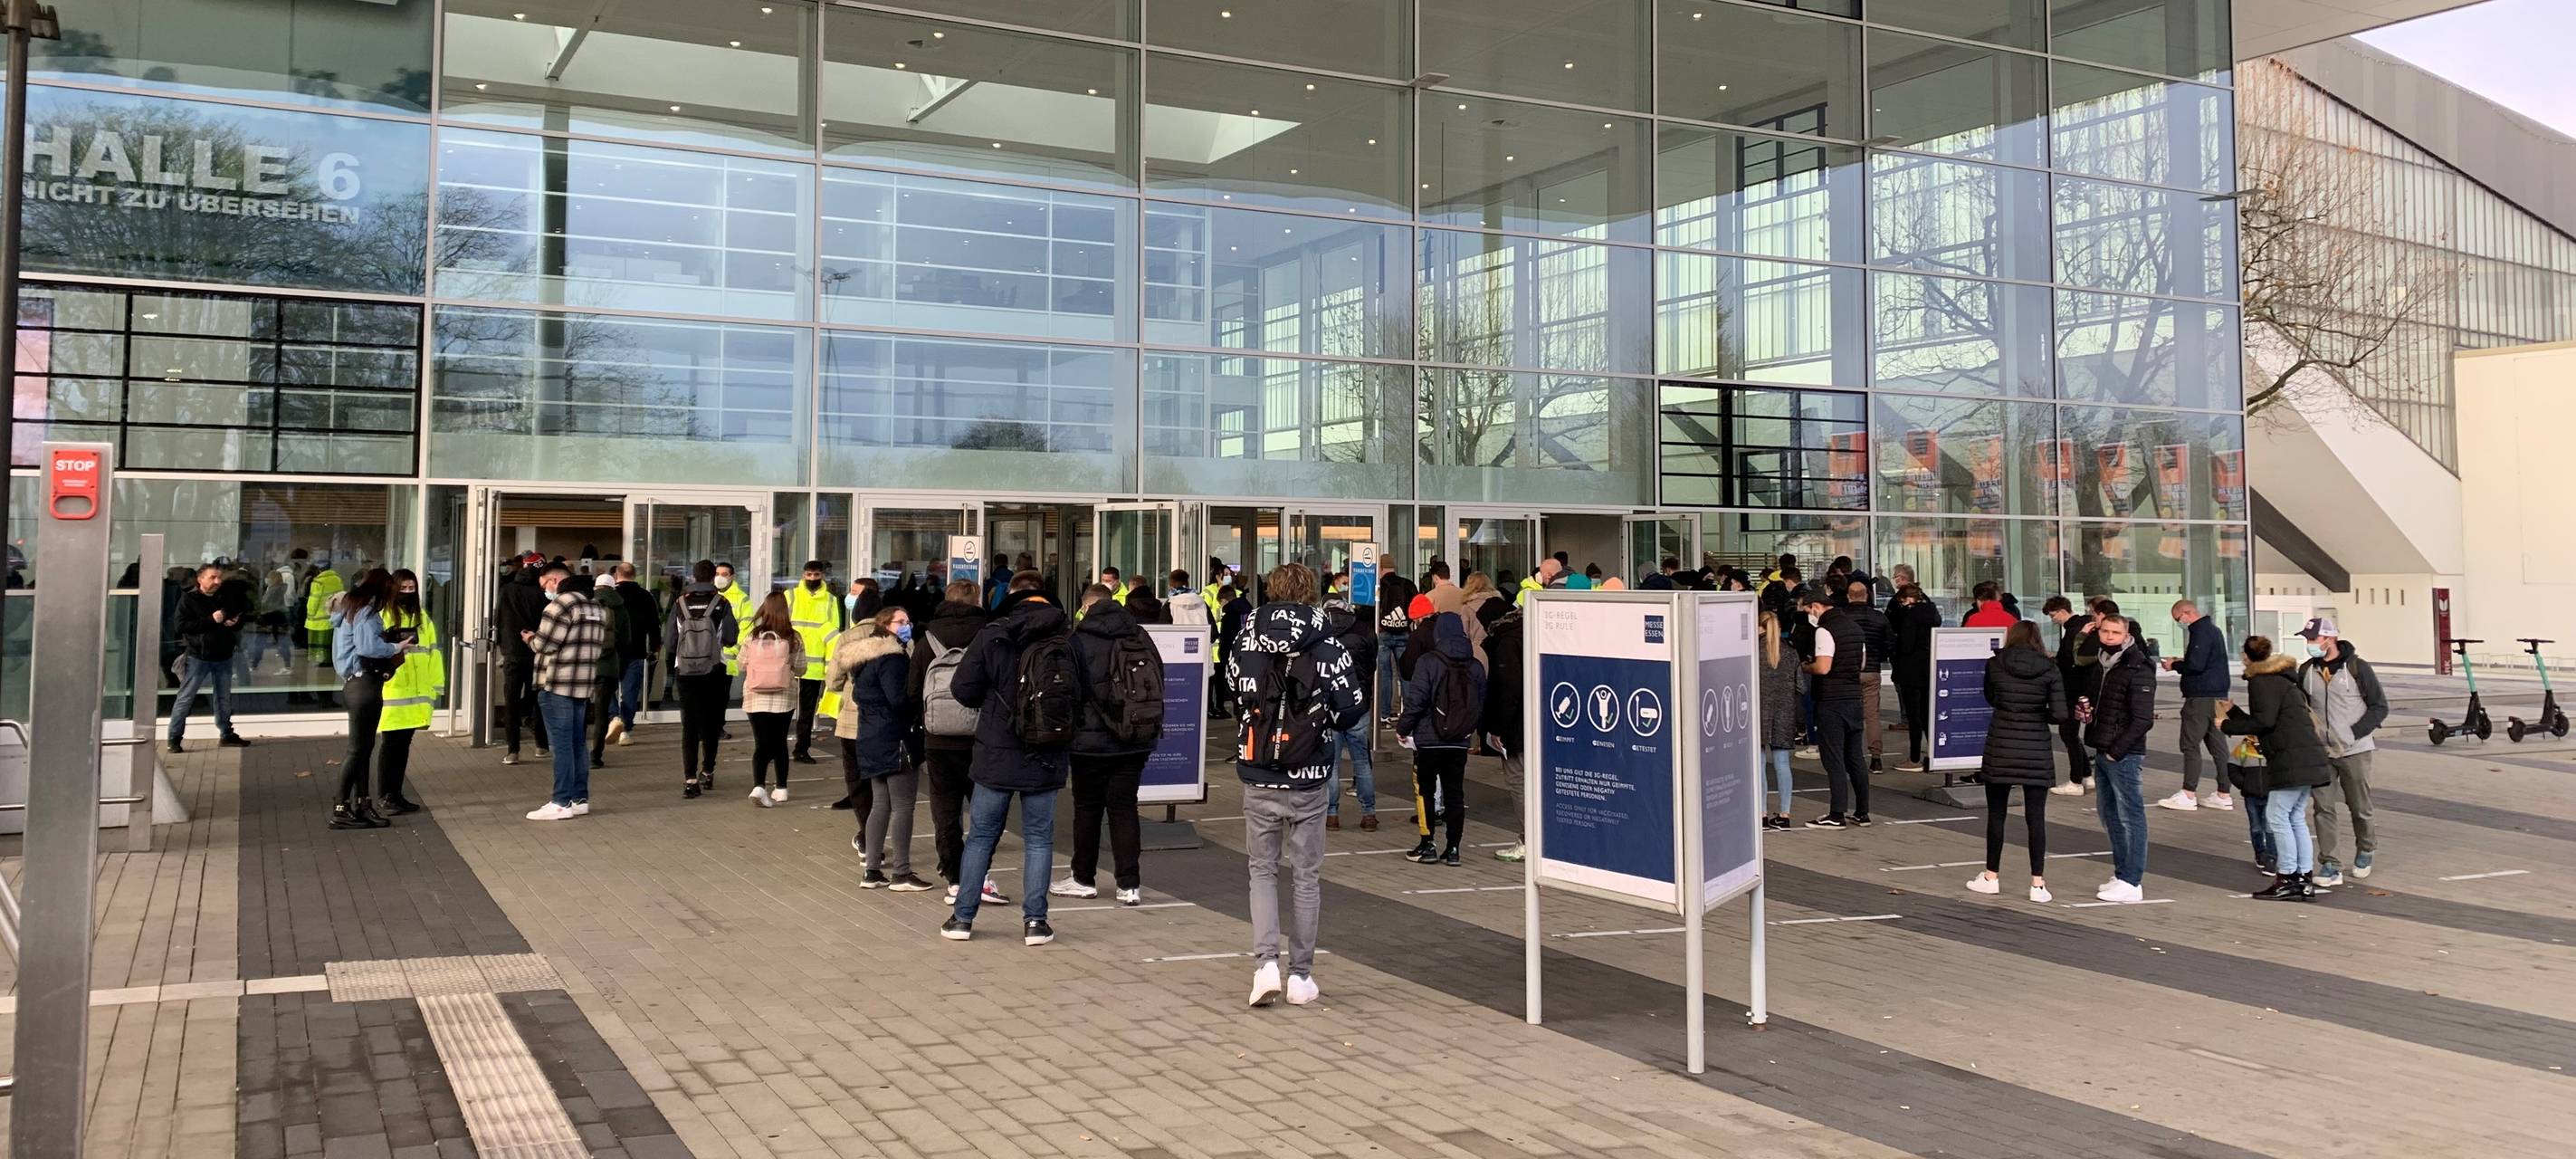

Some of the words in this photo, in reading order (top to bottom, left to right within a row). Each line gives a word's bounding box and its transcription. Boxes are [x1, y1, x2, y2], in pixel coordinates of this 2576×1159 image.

[24, 123, 290, 196] HALLE
[318, 152, 360, 200] 6
[22, 181, 116, 206] NICHT
[121, 188, 167, 209] ZU
[55, 460, 95, 471] STOP
[1644, 629, 1664, 637] ESSEN
